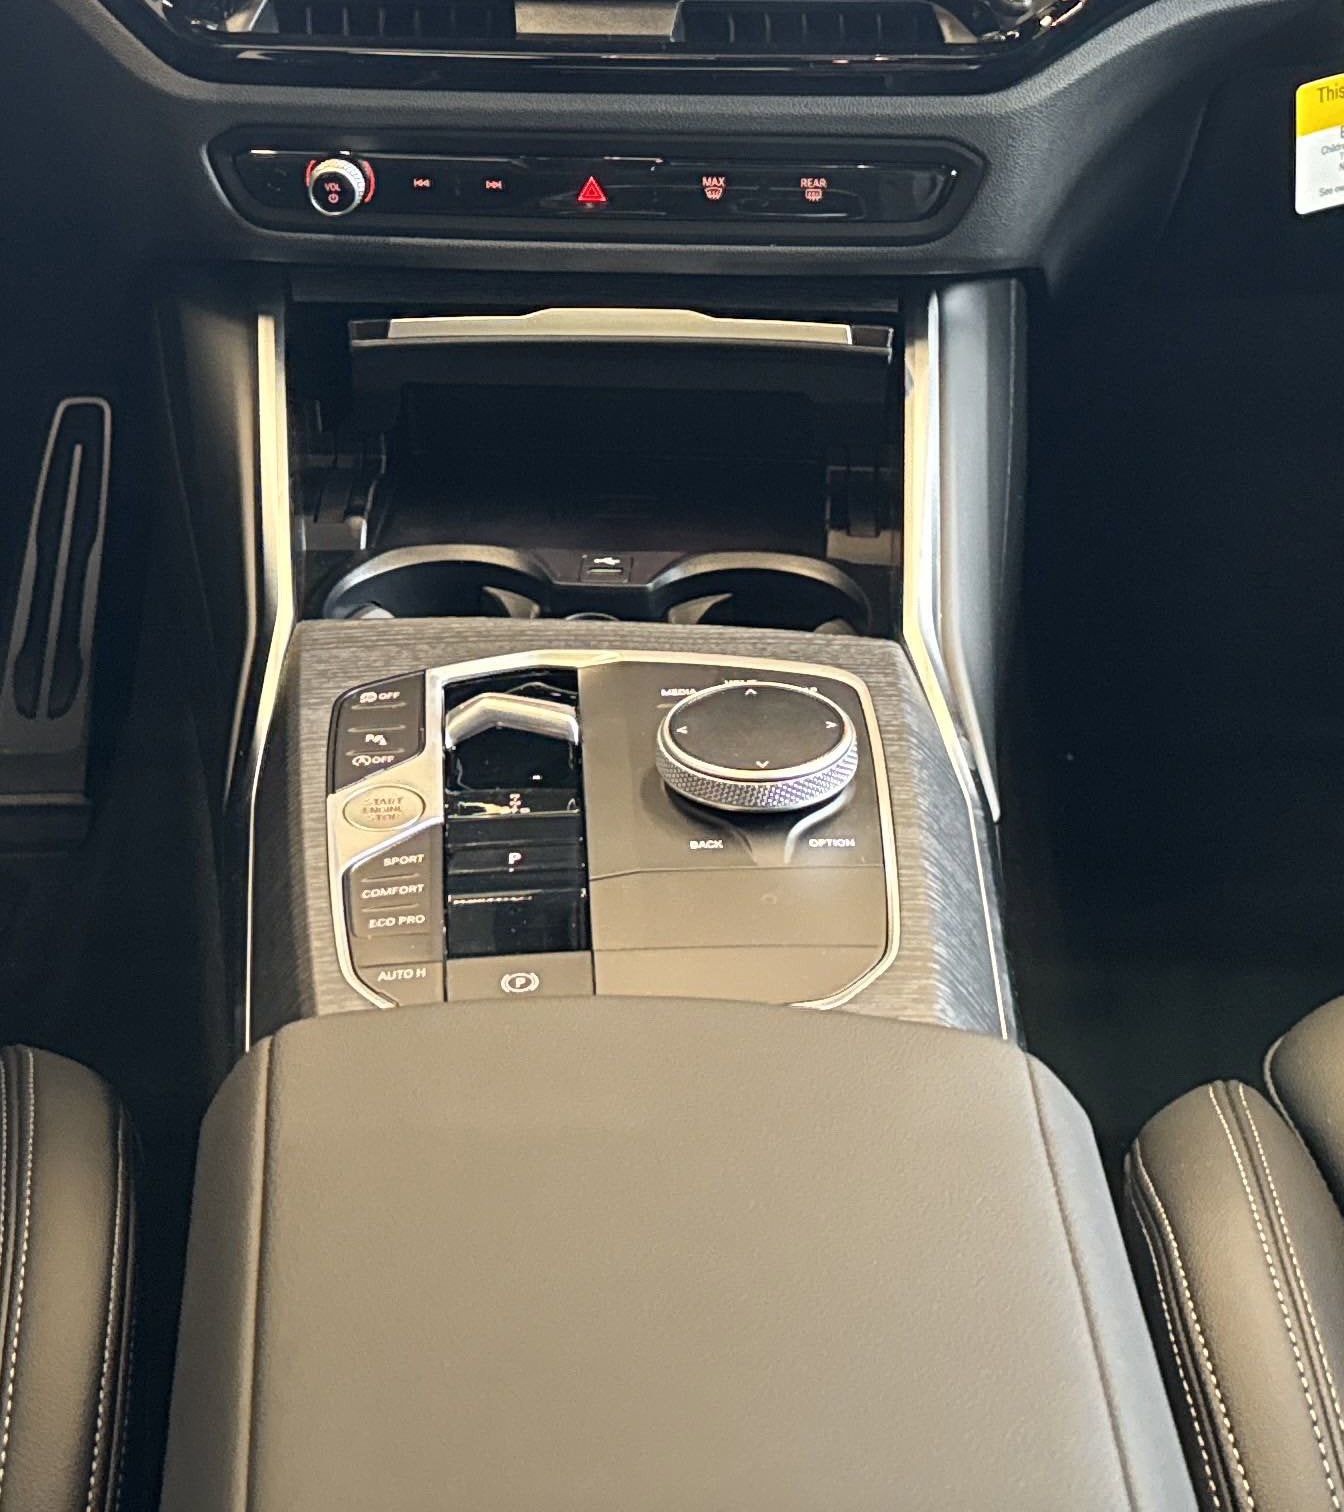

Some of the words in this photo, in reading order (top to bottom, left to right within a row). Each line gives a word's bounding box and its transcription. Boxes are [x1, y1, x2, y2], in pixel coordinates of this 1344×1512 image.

[702, 176, 726, 187] MAX
[800, 177, 828, 189] REAR
[378, 691, 401, 701] OFF
[372, 755, 395, 764] OFF
[689, 840, 724, 850] BACK
[808, 838, 856, 849] OPTION
[383, 854, 425, 868] SPORT
[508, 852, 522, 865] P
[361, 883, 425, 900] COMFORT
[368, 916, 396, 929] ECO
[398, 914, 426, 926] PRO
[377, 969, 413, 982] AUTO
[415, 967, 427, 979] H
